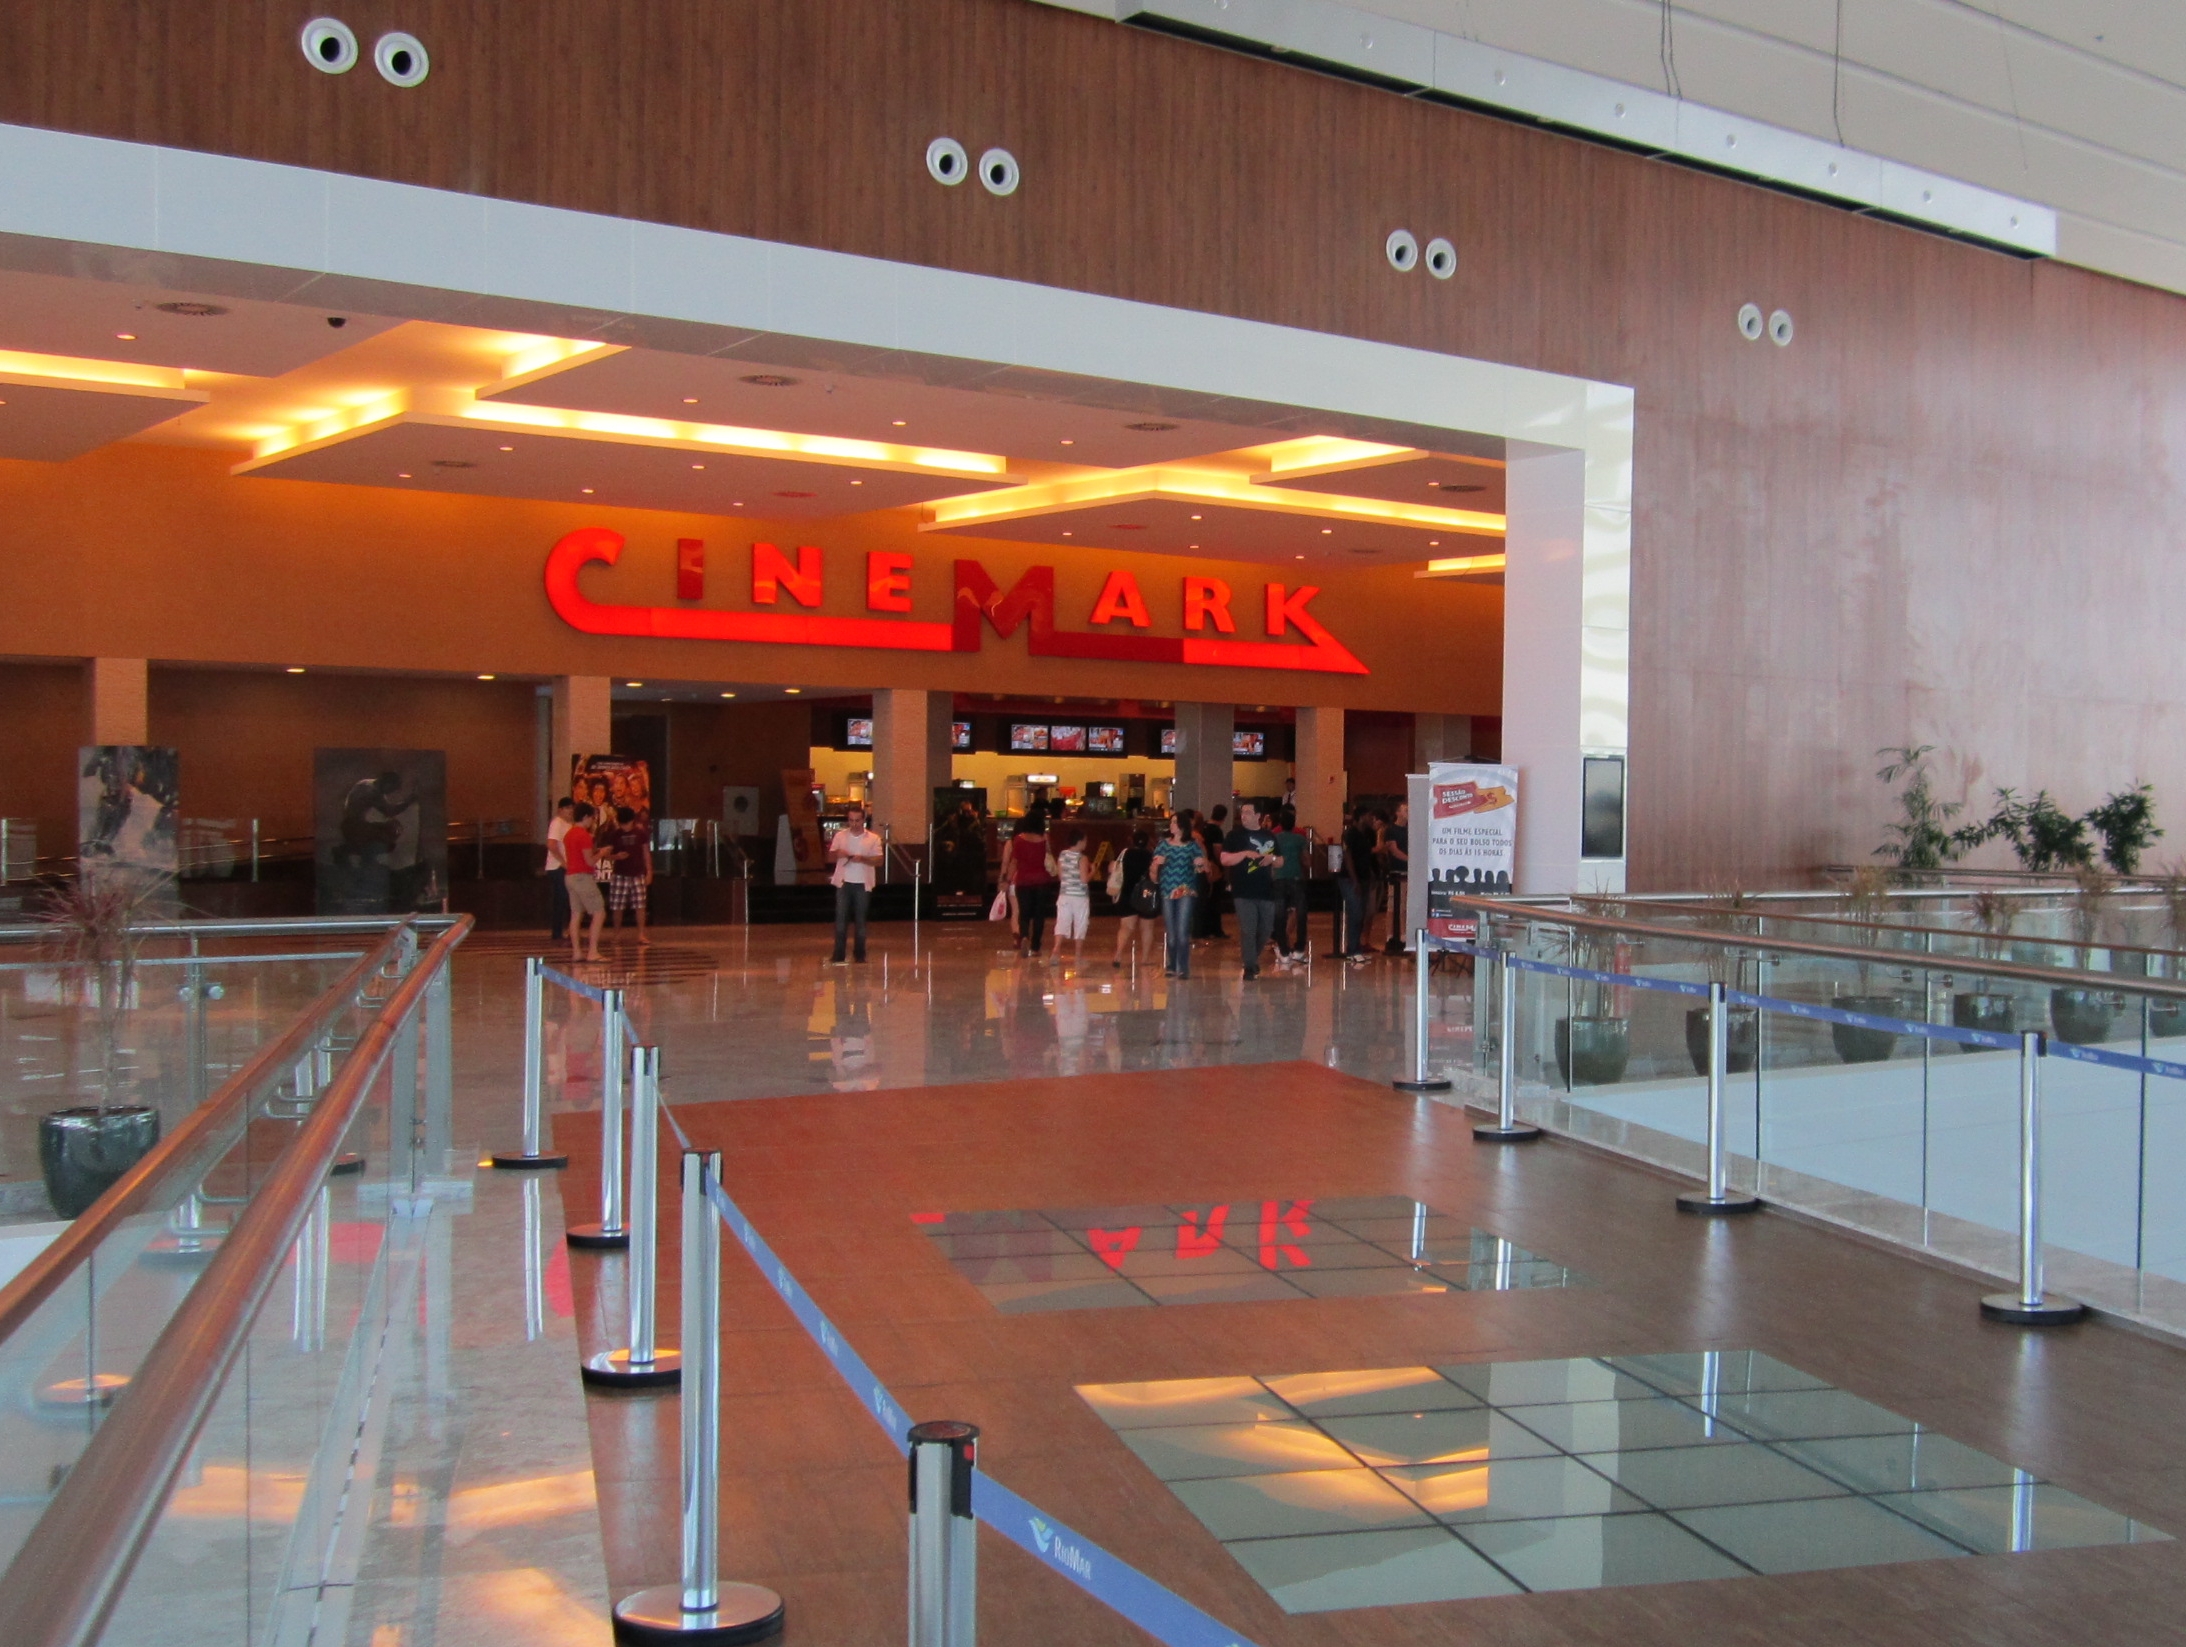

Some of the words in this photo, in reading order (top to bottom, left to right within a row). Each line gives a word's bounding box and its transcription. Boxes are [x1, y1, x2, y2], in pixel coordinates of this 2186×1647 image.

[544, 527, 1371, 675] CINEMARK
[1474, 828, 1503, 836] ESPECIAL
[1470, 838, 1491, 846] BOLSO
[1492, 839, 1512, 847] TODOS
[1449, 848, 1463, 856] DIAS
[1483, 849, 1503, 857] HORAS
